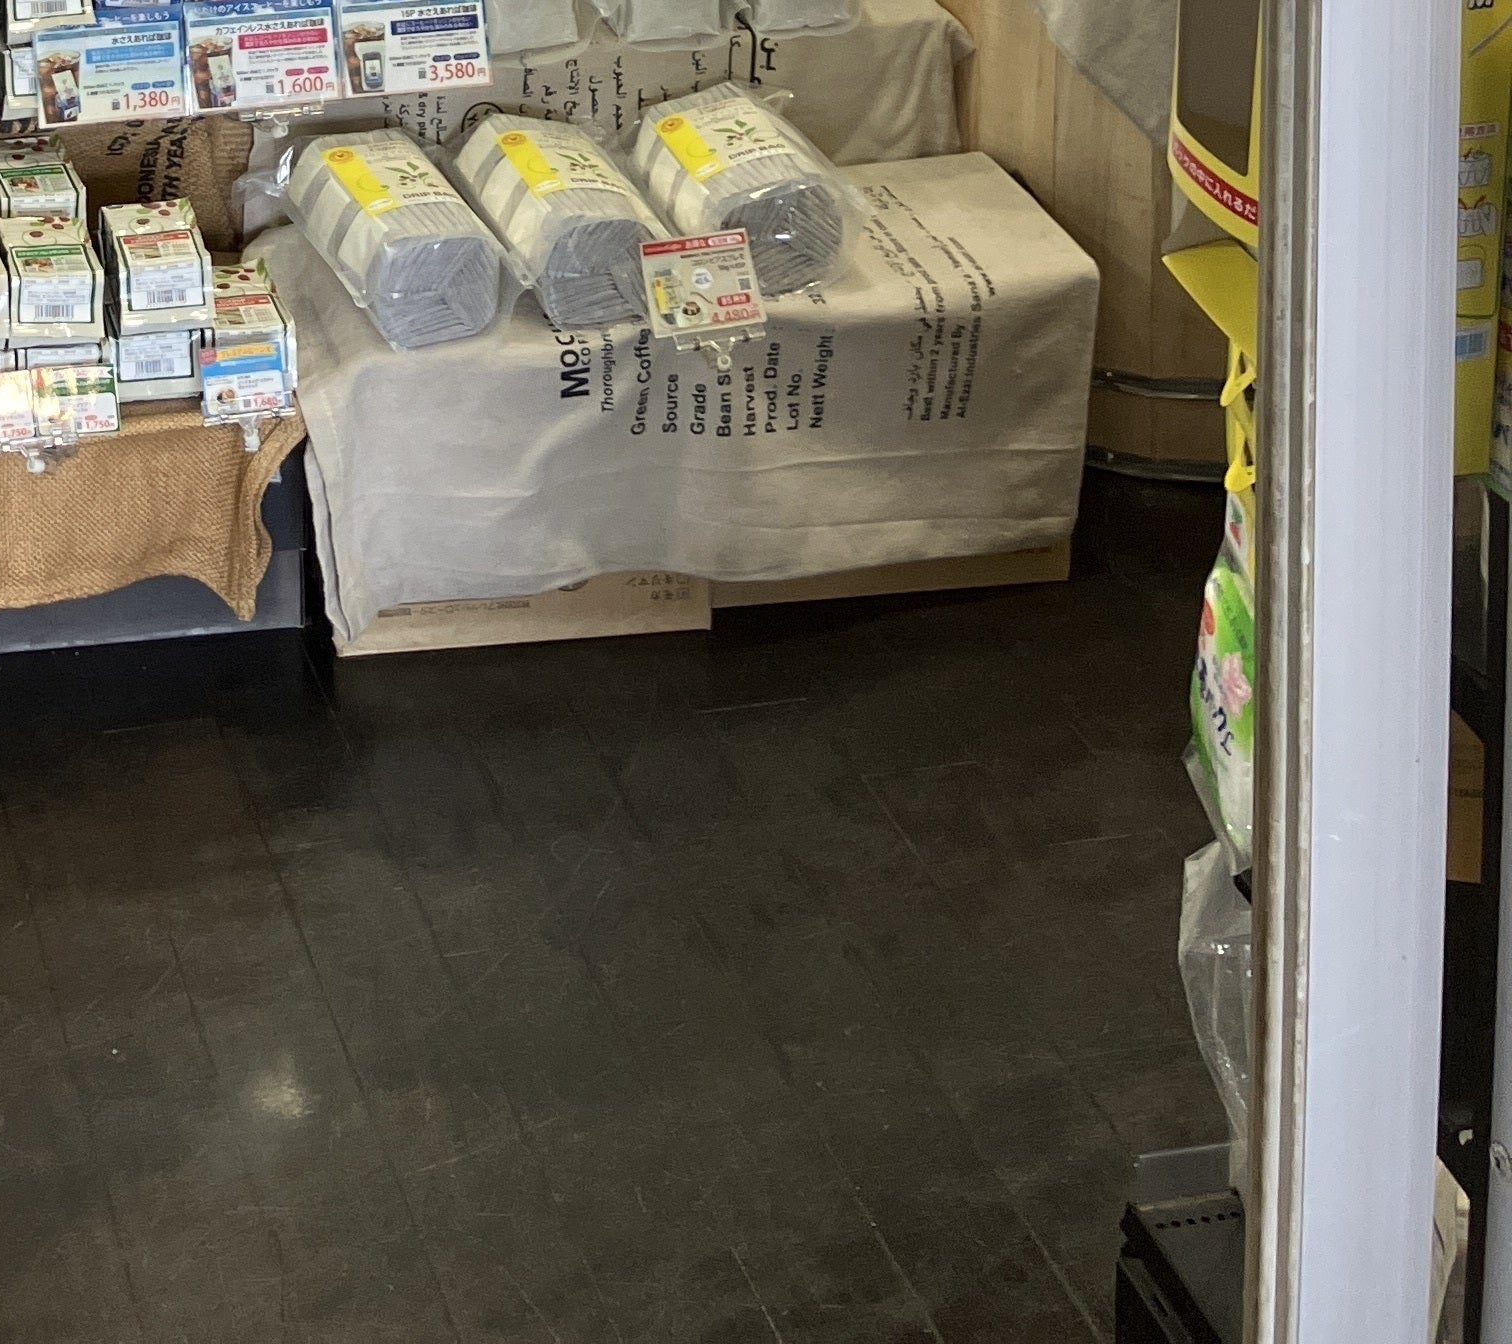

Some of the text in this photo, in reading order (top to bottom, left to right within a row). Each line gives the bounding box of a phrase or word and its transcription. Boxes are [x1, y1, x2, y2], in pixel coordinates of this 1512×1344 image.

[277, 75, 335, 94] 1,600円
[428, 60, 487, 81] 3,580円
[123, 88, 181, 109] 1,380円
[630, 328, 654, 436] Green Coffee
[763, 341, 782, 379] Date
[809, 334, 836, 429] Nett Weight
[662, 373, 679, 434] Source
[690, 383, 707, 436] Grade
[716, 387, 733, 437] Bean
[743, 366, 757, 437] Harvest
[786, 396, 801, 431] Lot
